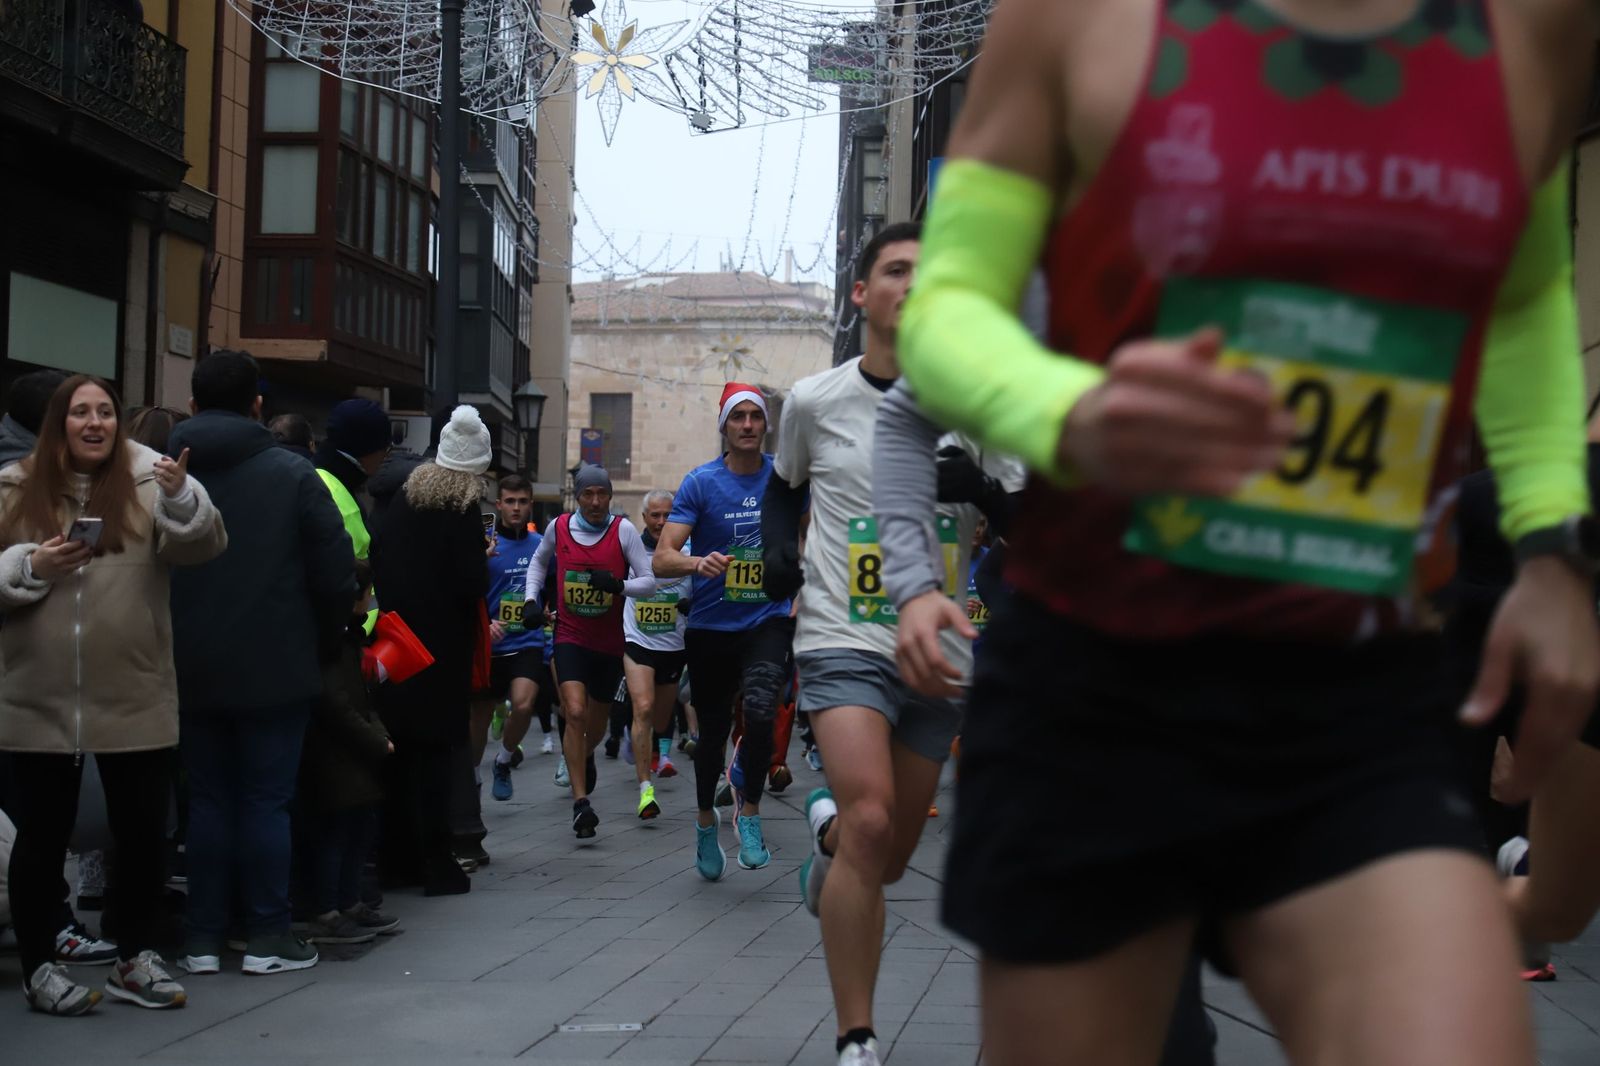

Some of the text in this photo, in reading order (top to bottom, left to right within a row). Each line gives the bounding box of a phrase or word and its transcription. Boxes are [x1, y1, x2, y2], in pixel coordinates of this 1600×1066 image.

[1252, 147, 1368, 196] APIS
[742, 497, 757, 507] 46
[517, 557, 528, 565] 46
[733, 562, 761, 585] 113
[857, 554, 882, 594] 8
[567, 587, 605, 605] 1324
[502, 605, 523, 620] 69
[638, 606, 671, 622] 1255
